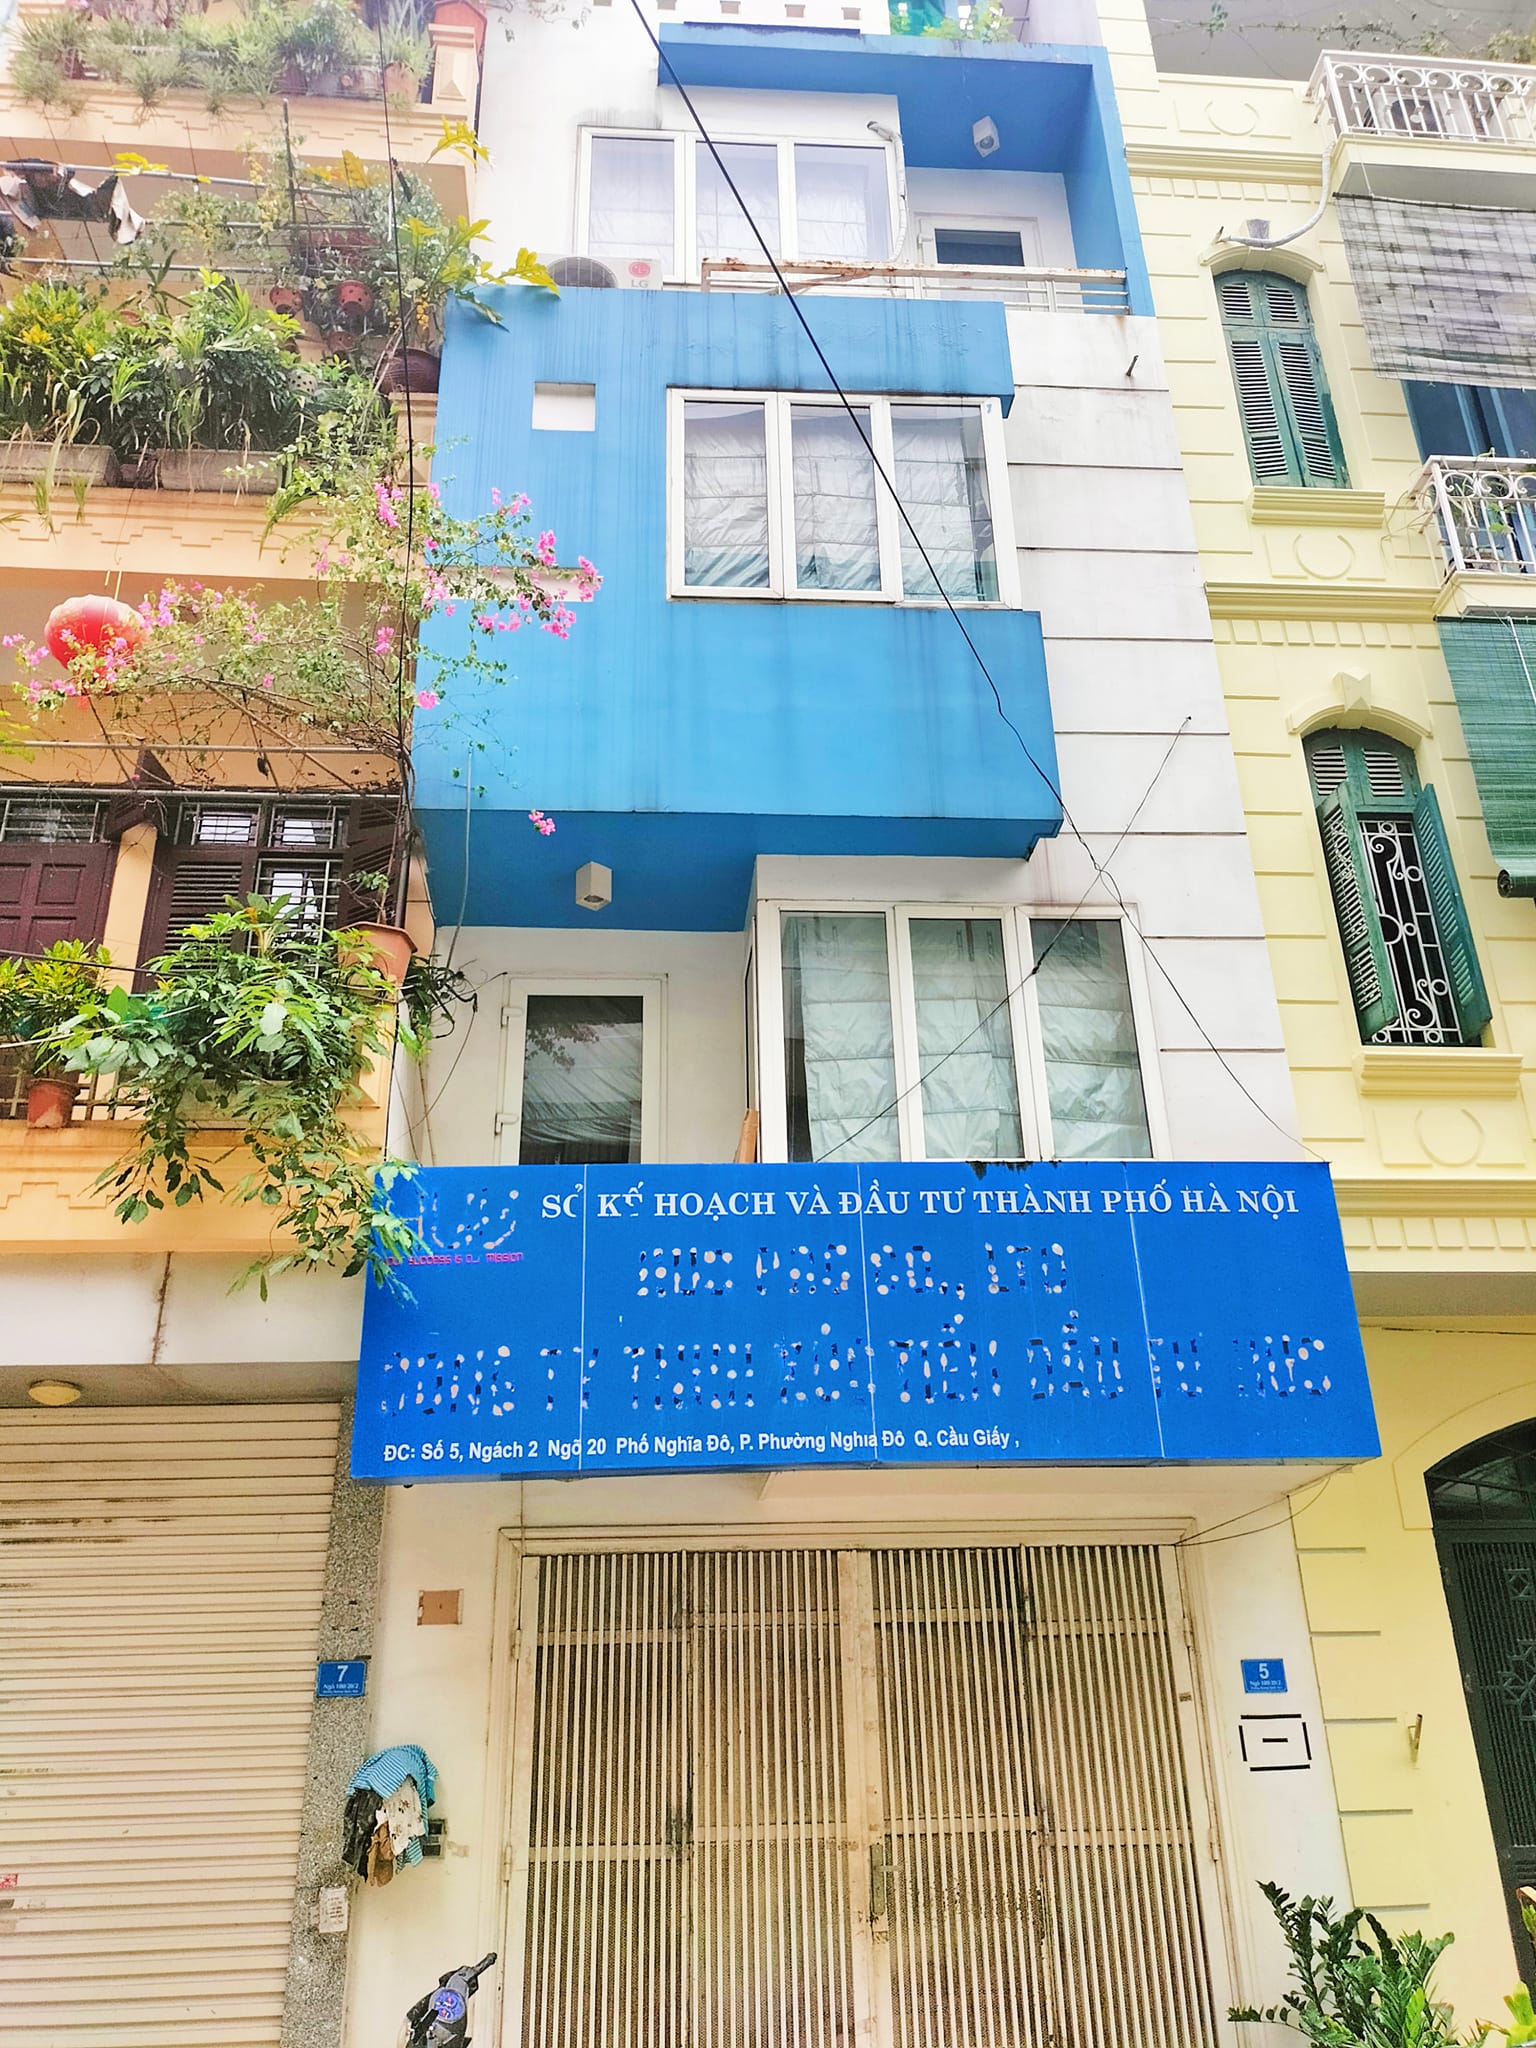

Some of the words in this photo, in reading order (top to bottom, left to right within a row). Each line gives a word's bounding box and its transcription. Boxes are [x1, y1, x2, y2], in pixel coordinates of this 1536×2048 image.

[631, 279, 649, 289] LG
[654, 1192, 776, 1222] HOẠCH
[785, 1183, 832, 1215] VÀ
[838, 1178, 911, 1215] ĐẦU
[919, 1187, 967, 1215] TƯ
[973, 1183, 1093, 1215] THÀNH
[1100, 1178, 1172, 1214] PHỐ
[1180, 1182, 1231, 1214] HÀ
[1236, 1183, 1300, 1221] NỘI
[383, 1444, 416, 1462] ĐC:
[421, 1439, 445, 1461] Số
[449, 1442, 464, 1463] 5,
[469, 1440, 524, 1463] Ngách
[527, 1440, 539, 1458] 2
[548, 1438, 581, 1460] Ngõ
[587, 1438, 607, 1455] 20
[616, 1433, 649, 1455] Phố
[654, 1435, 703, 1457] Nghĩa
[706, 1434, 735, 1454] Đô,
[740, 1433, 754, 1451] P.
[759, 1433, 826, 1453] Phường
[881, 1429, 905, 1447] Đô
[914, 1430, 932, 1448] Q.
[936, 1425, 969, 1447] Cầu
[973, 1425, 1010, 1449] Giấy
[337, 1664, 349, 1682] 7
[1259, 1662, 1270, 1680] 5
